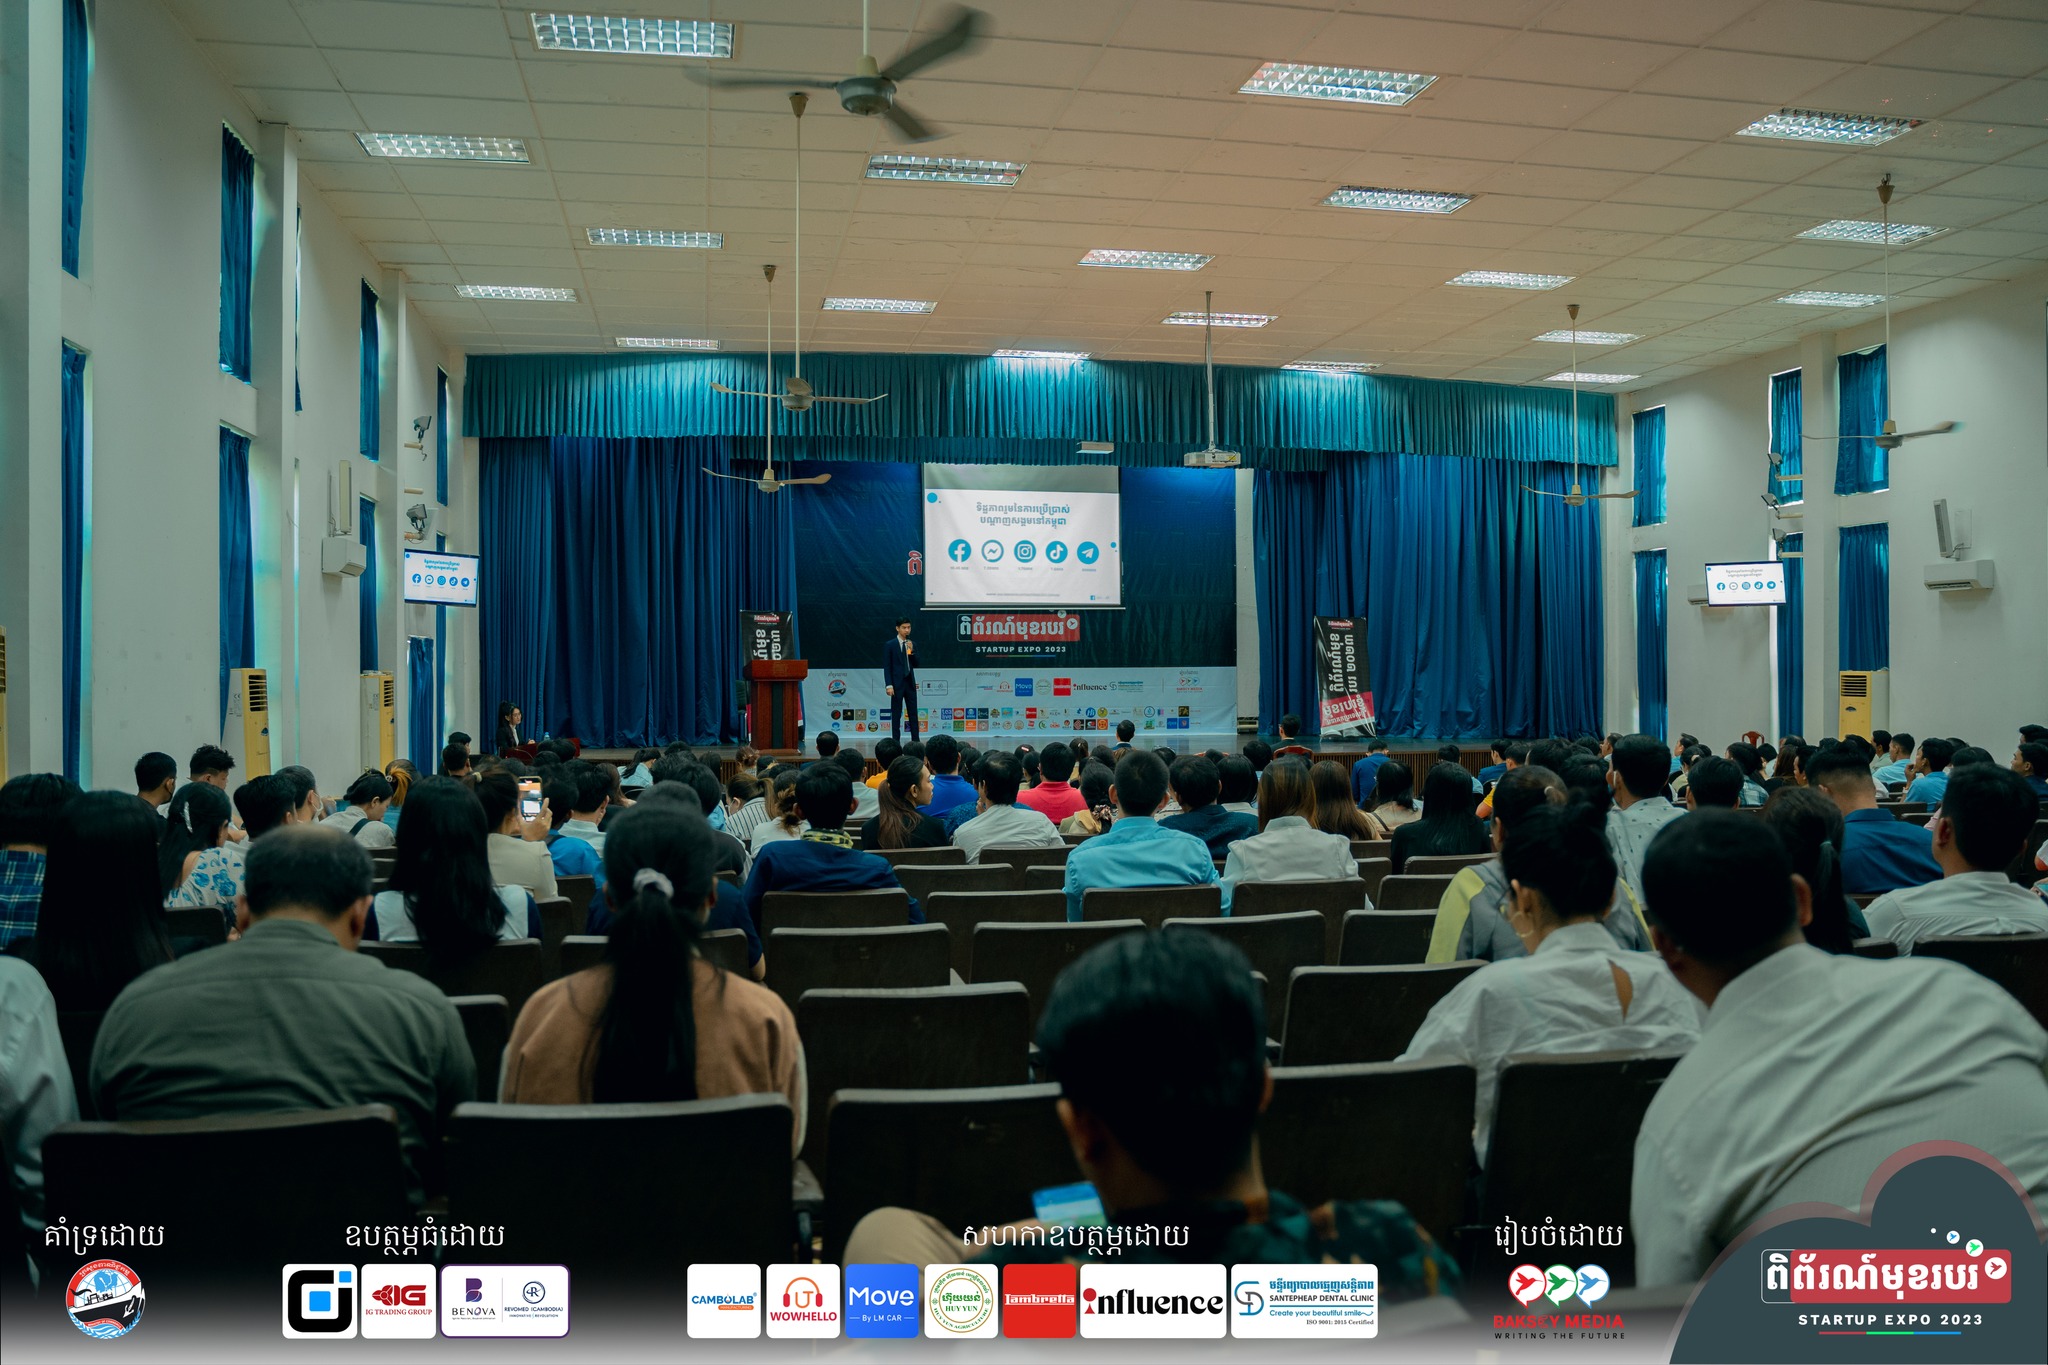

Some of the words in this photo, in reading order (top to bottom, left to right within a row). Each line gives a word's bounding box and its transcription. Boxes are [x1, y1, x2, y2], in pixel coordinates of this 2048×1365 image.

[960, 615, 1064, 640] ពិព័រណ៍មុខរបរ
[1073, 683, 1107, 691] influence
